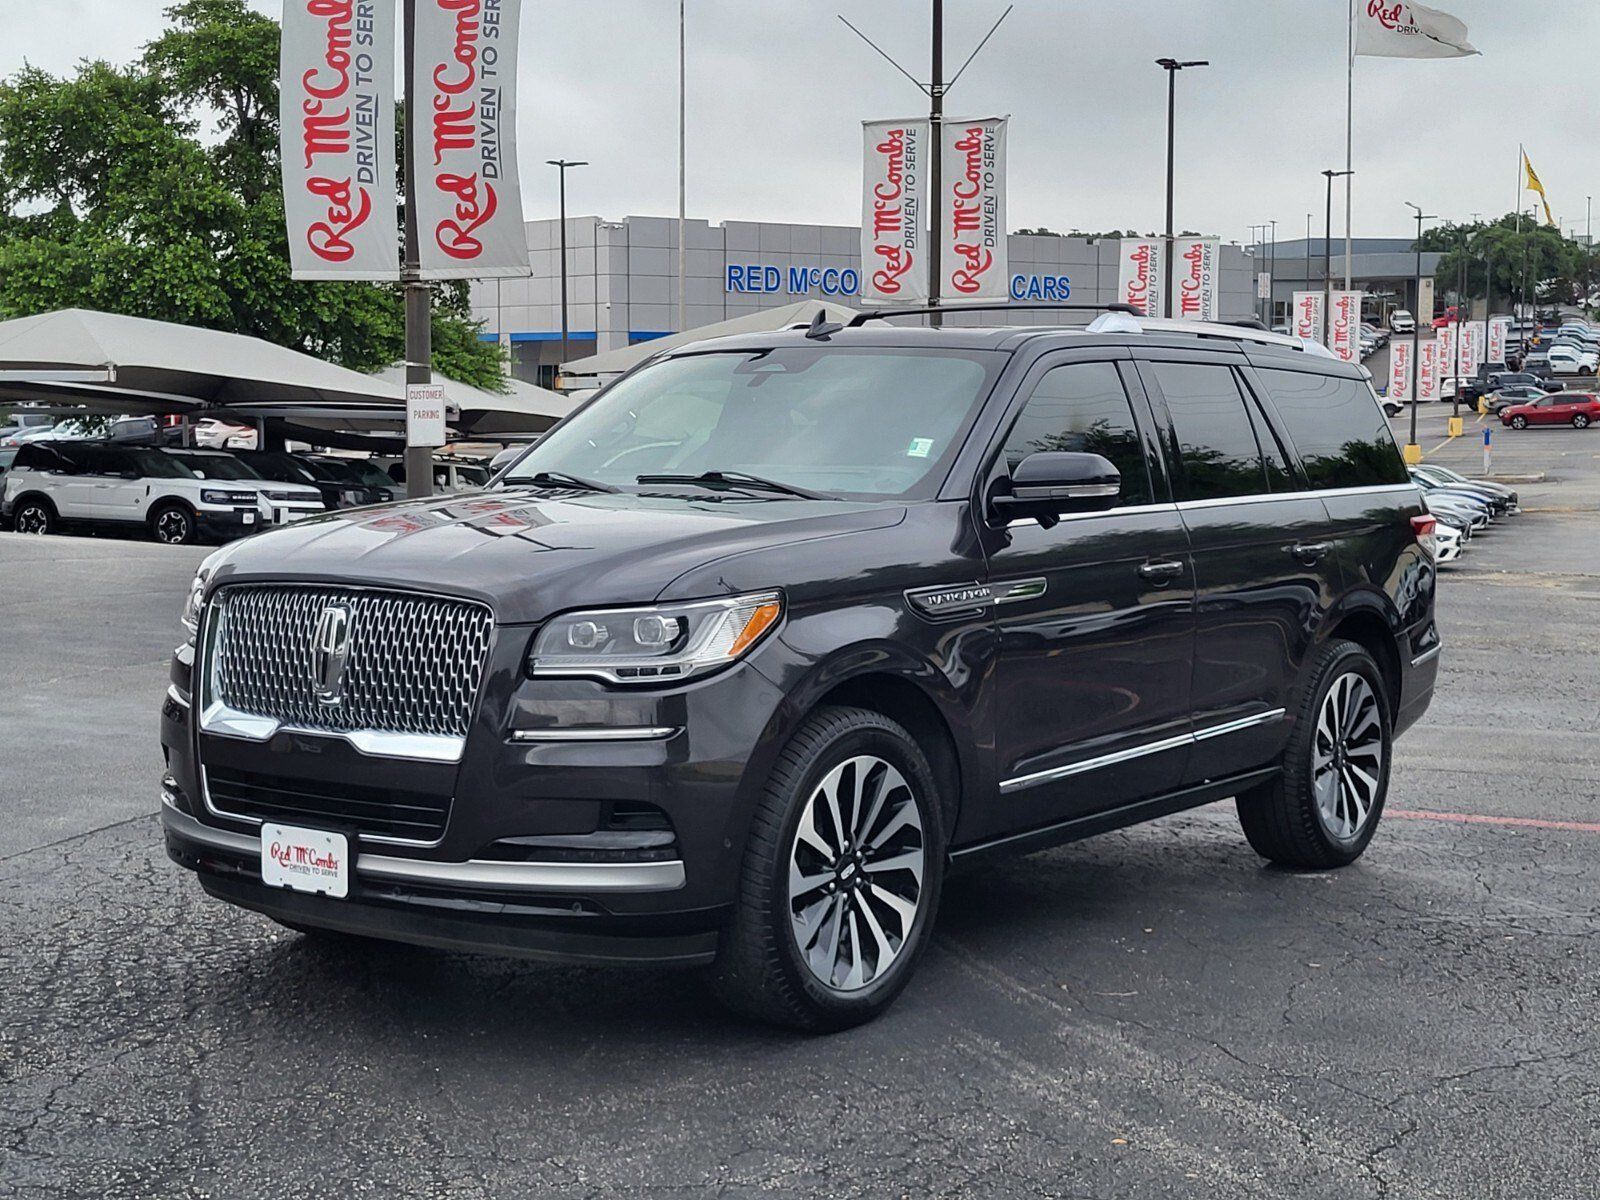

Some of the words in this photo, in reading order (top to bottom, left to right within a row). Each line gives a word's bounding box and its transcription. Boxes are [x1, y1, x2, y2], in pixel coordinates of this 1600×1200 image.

[356, 0, 374, 46] SER
[482, 0, 500, 39] SER
[1367, 0, 1402, 29] Red
[1396, 24, 1420, 34] DRIV
[355, 54, 373, 86] TO
[481, 46, 498, 79] TO
[302, 0, 353, 169] McComb
[433, 0, 481, 166] McComb
[356, 94, 374, 184] DRIVEN
[482, 87, 498, 180] DRIVEN
[905, 128, 917, 170] SERVE
[984, 126, 995, 168] SERVE
[874, 129, 904, 240] McCombs
[905, 174, 916, 193] TO
[953, 127, 983, 240] McCombs
[984, 172, 995, 191] TO
[307, 177, 372, 262] Red
[435, 172, 498, 260] Red
[904, 198, 915, 249] DRIVEN
[984, 196, 995, 248] DRIVEN
[872, 245, 913, 294] Red
[952, 244, 993, 293] Red
[1149, 244, 1158, 272] SERVE
[1203, 243, 1212, 271] SERVE
[727, 265, 781, 293] RED
[788, 267, 859, 295] McCO
[1011, 275, 1071, 299] CARS
[1149, 275, 1157, 288] TO
[1181, 243, 1203, 318] McCombs
[1203, 273, 1211, 287] TO
[1148, 290, 1157, 318] RIVEN
[1335, 346, 1353, 361] ed
[409, 390, 443, 400] CUSTOMER
[413, 410, 440, 420] PARKING
[270, 841, 292, 867] Red
[293, 845, 338, 870] McCombs
[289, 864, 311, 874] DRIVEN
[321, 869, 338, 878] SERVE
